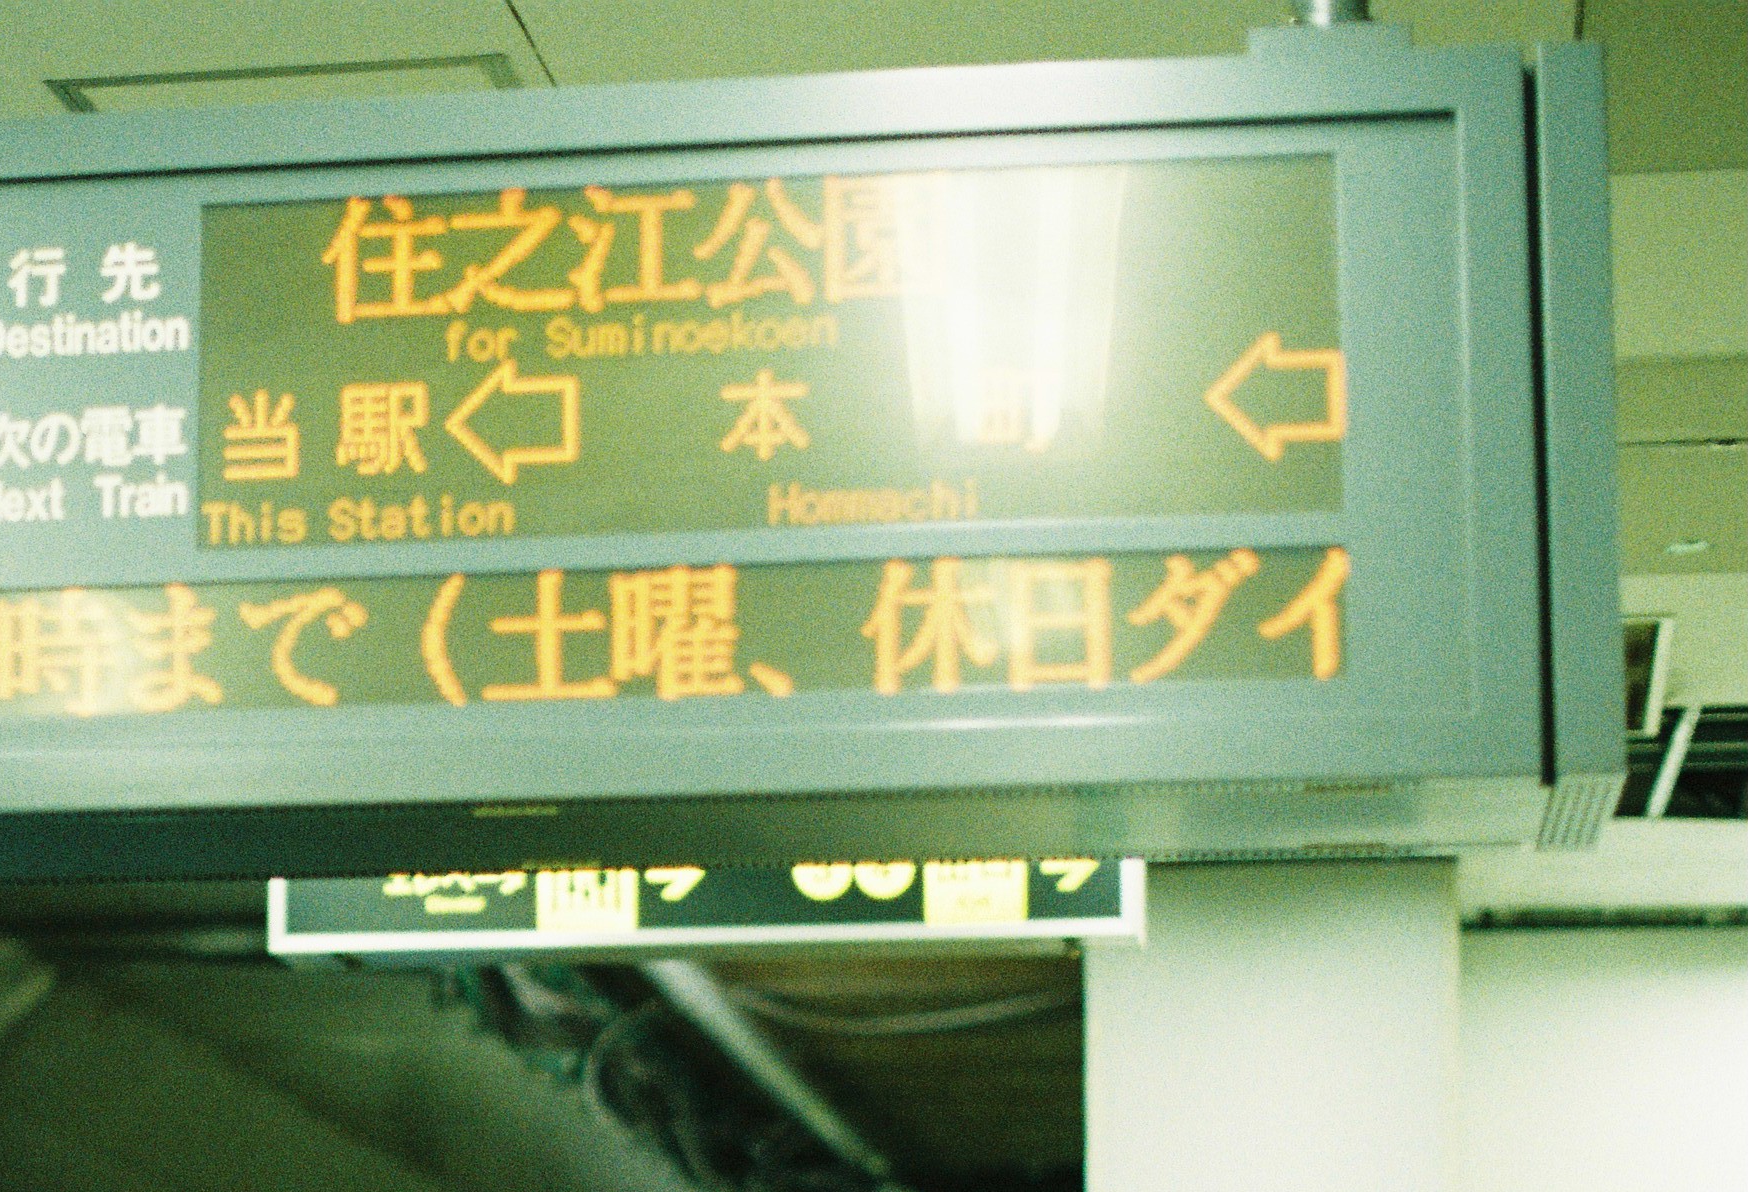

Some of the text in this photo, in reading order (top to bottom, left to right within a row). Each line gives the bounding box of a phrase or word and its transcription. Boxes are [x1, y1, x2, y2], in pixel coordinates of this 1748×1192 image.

[322, 169, 949, 323] 住之江公園
[445, 311, 839, 362] for Suminoekoen
[93, 471, 189, 518] Train
[201, 494, 516, 546] This Station
